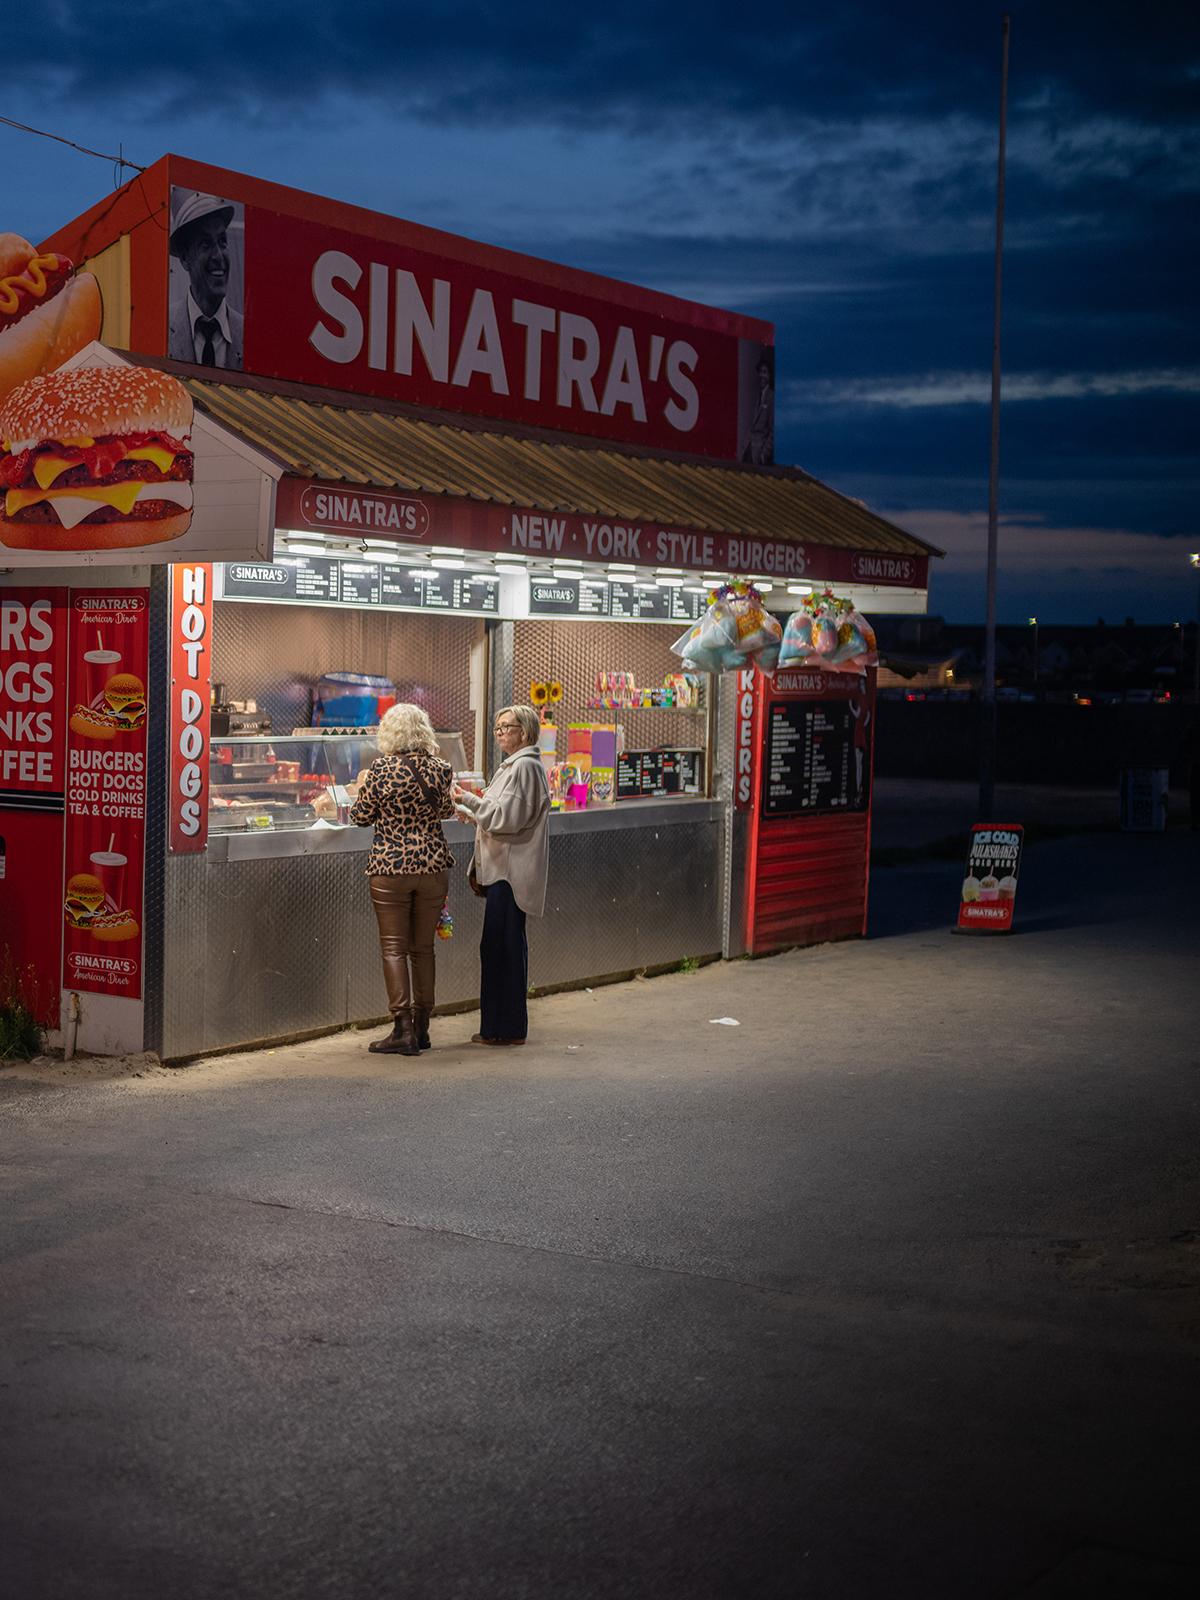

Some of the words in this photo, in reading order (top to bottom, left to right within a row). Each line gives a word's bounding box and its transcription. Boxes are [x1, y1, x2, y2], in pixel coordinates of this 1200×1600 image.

[308, 249, 700, 433] SINATRA'S
[314, 493, 417, 530] SINATRA'S
[511, 513, 567, 551] NEW
[583, 523, 641, 559] YORK
[656, 531, 714, 566] STYLE
[727, 539, 805, 575] BURGERS
[236, 567, 283, 581] SINATRA'S
[858, 555, 911, 579] SINATRA'S
[537, 588, 571, 600] SINATRA'S
[81, 598, 139, 610] SINATRA'S
[80, 612, 115, 624] American
[115, 612, 138, 625] Diner
[181, 566, 204, 679] HOT
[776, 674, 823, 690] SINATRA'S
[738, 669, 754, 802] RGERS
[69, 749, 144, 772] BURGERS
[179, 688, 202, 837] DOGS
[69, 771, 100, 787] HOT
[103, 773, 144, 790] DOGS
[69, 788, 99, 801] COLD
[101, 791, 144, 806] DRINKS
[69, 802, 90, 816] TEA
[91, 805, 100, 816] &
[102, 805, 144, 820] COFFEE
[974, 831, 992, 844] ICE
[992, 831, 1019, 846] COLD
[74, 955, 130, 972] SINATRA'S
